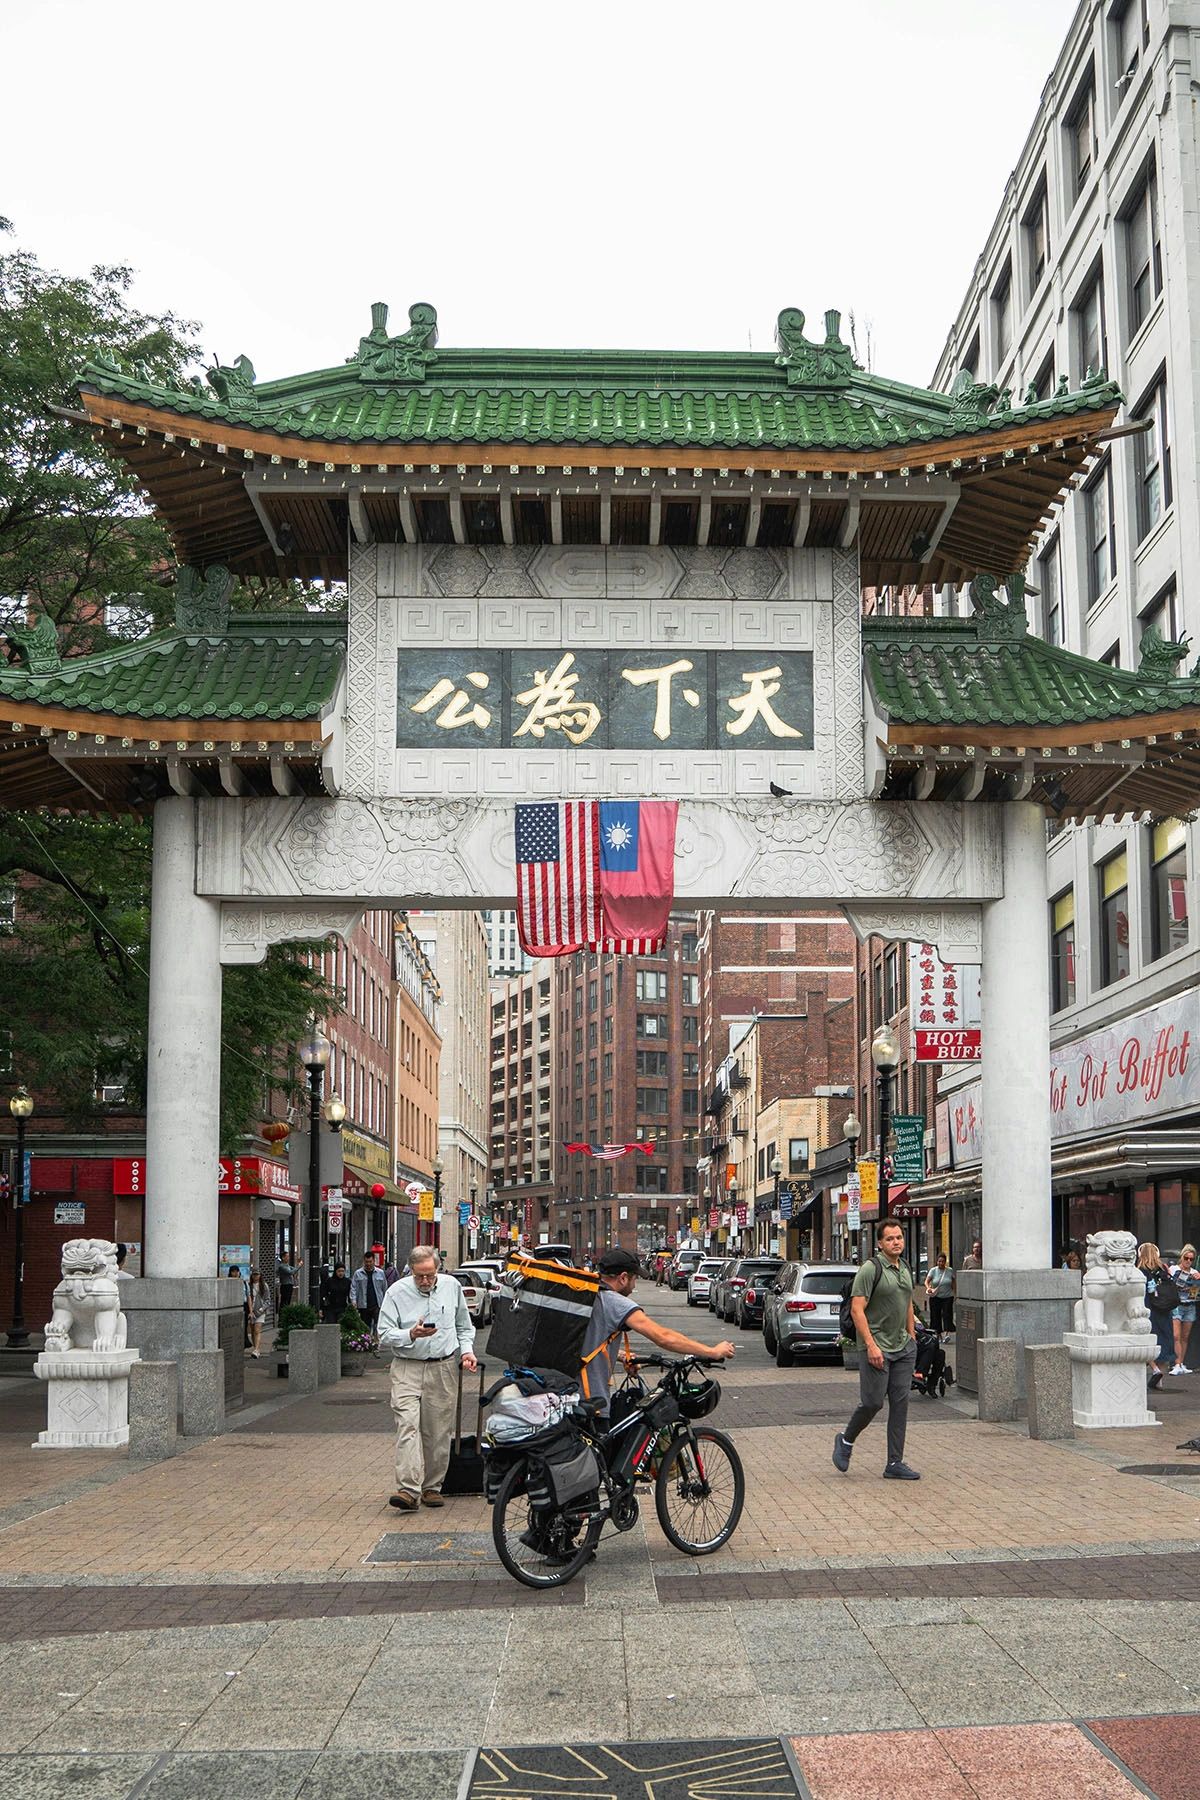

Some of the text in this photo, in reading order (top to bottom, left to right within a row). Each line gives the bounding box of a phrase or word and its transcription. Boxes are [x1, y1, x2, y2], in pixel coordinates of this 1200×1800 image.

[925, 1032, 967, 1046] HOT
[1076, 1053, 1108, 1107] Pot
[1116, 1024, 1191, 1102] Buffet
